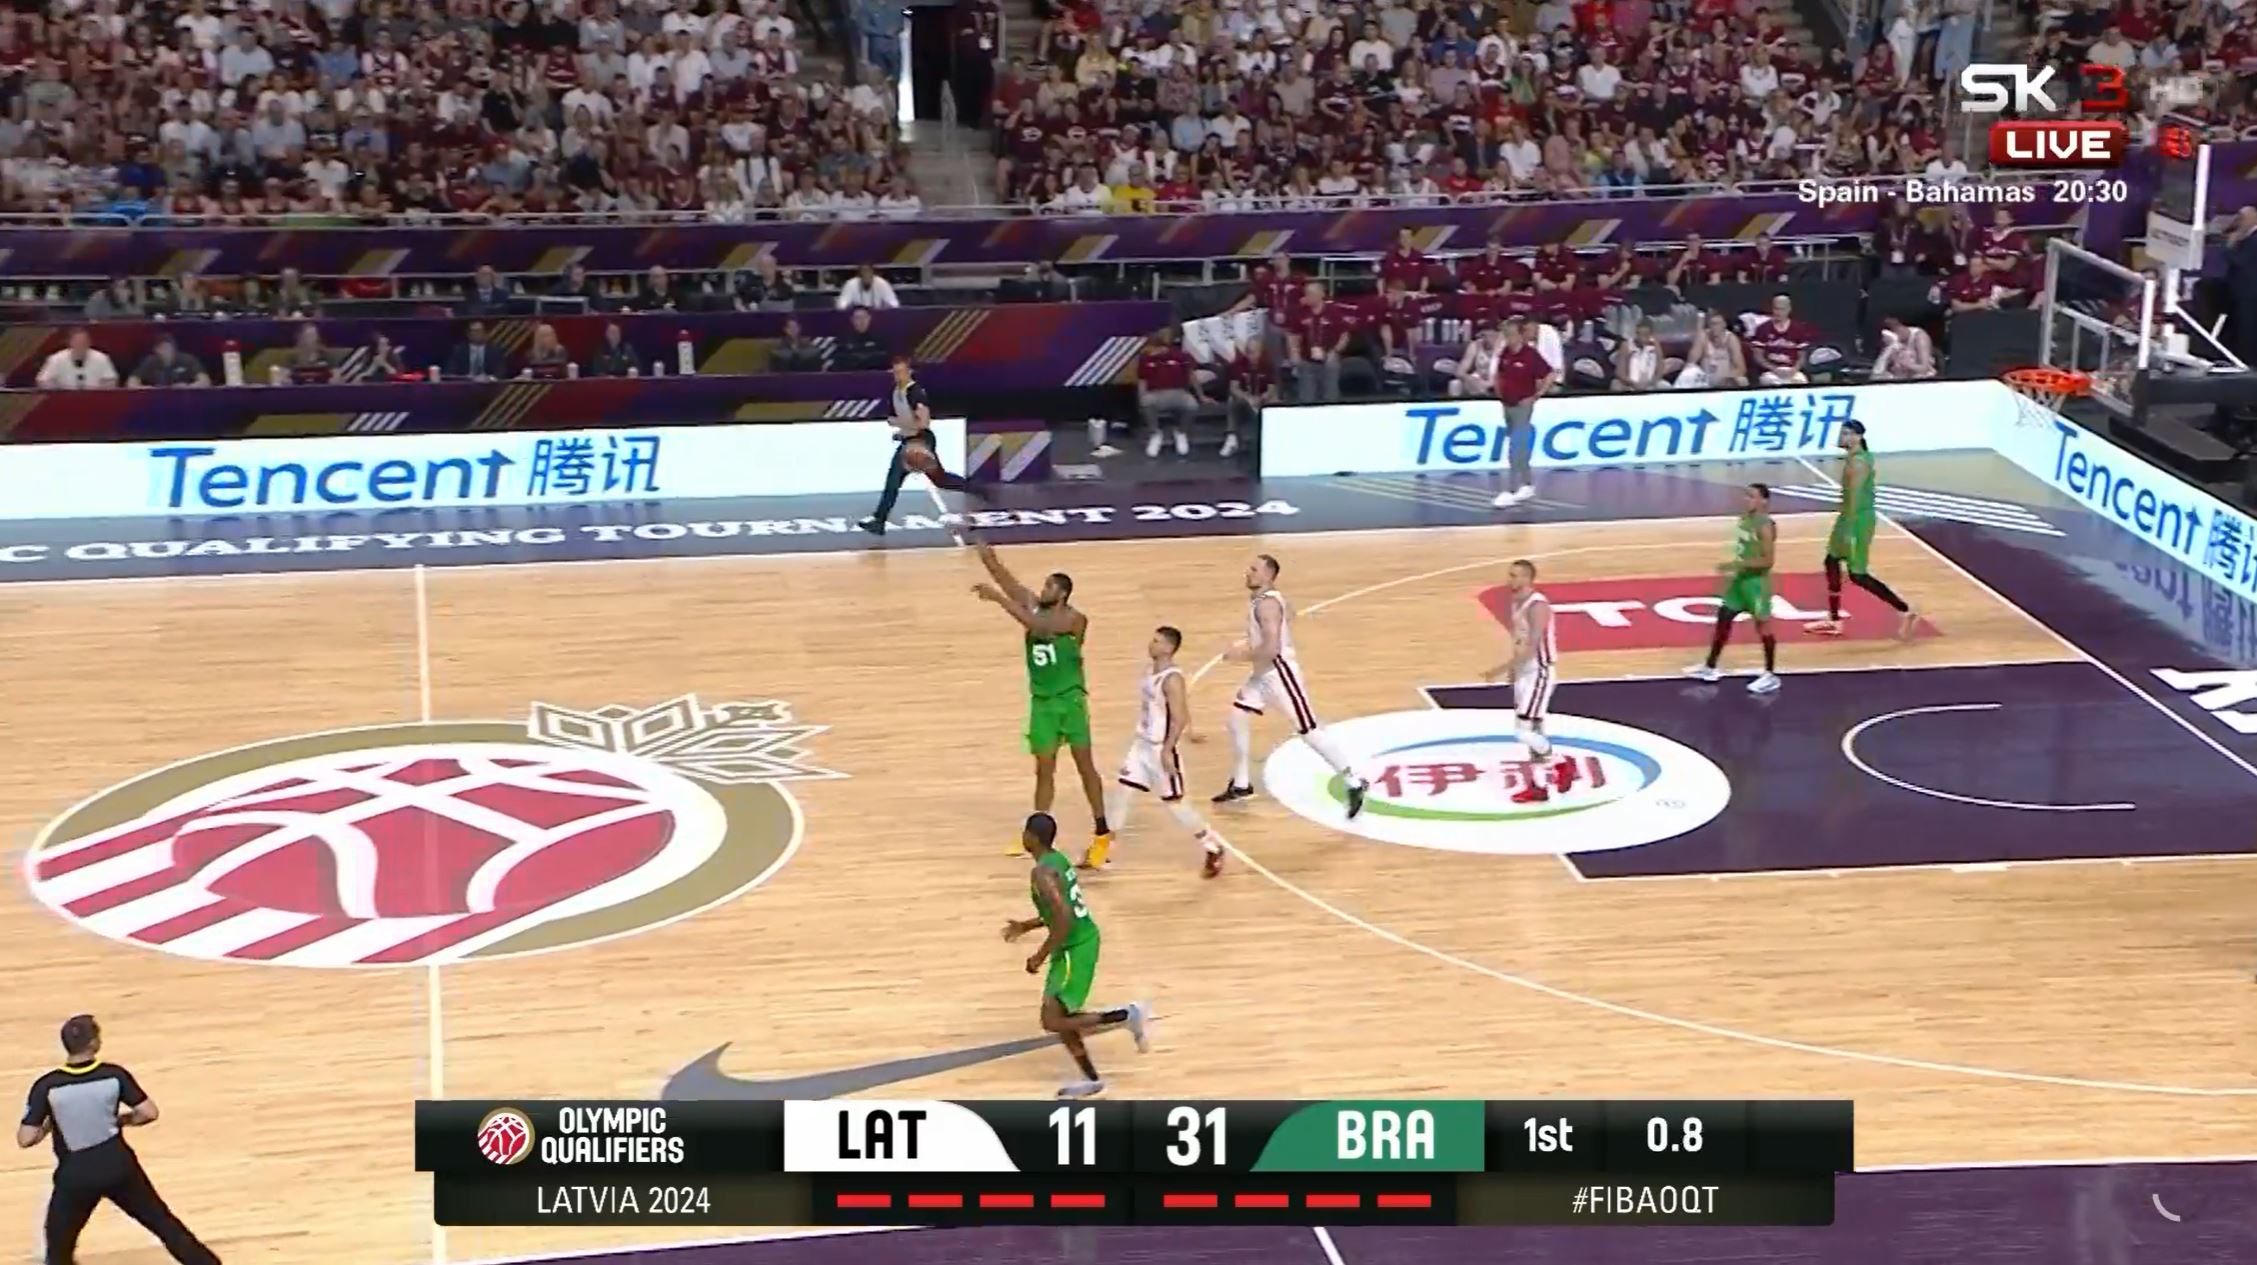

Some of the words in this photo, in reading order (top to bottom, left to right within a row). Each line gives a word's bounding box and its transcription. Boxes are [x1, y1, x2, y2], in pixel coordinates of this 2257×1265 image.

[1728, 393, 1857, 453] 腾讯
[150, 446, 514, 509] Tencent
[526, 435, 662, 497] 腾讯
[2054, 420, 2203, 556] Tencent
[64, 528, 567, 562] QUALIFYING
[1131, 500, 1300, 522] 2024
[1548, 594, 1852, 628] TCL
[1032, 642, 1057, 667] 51
